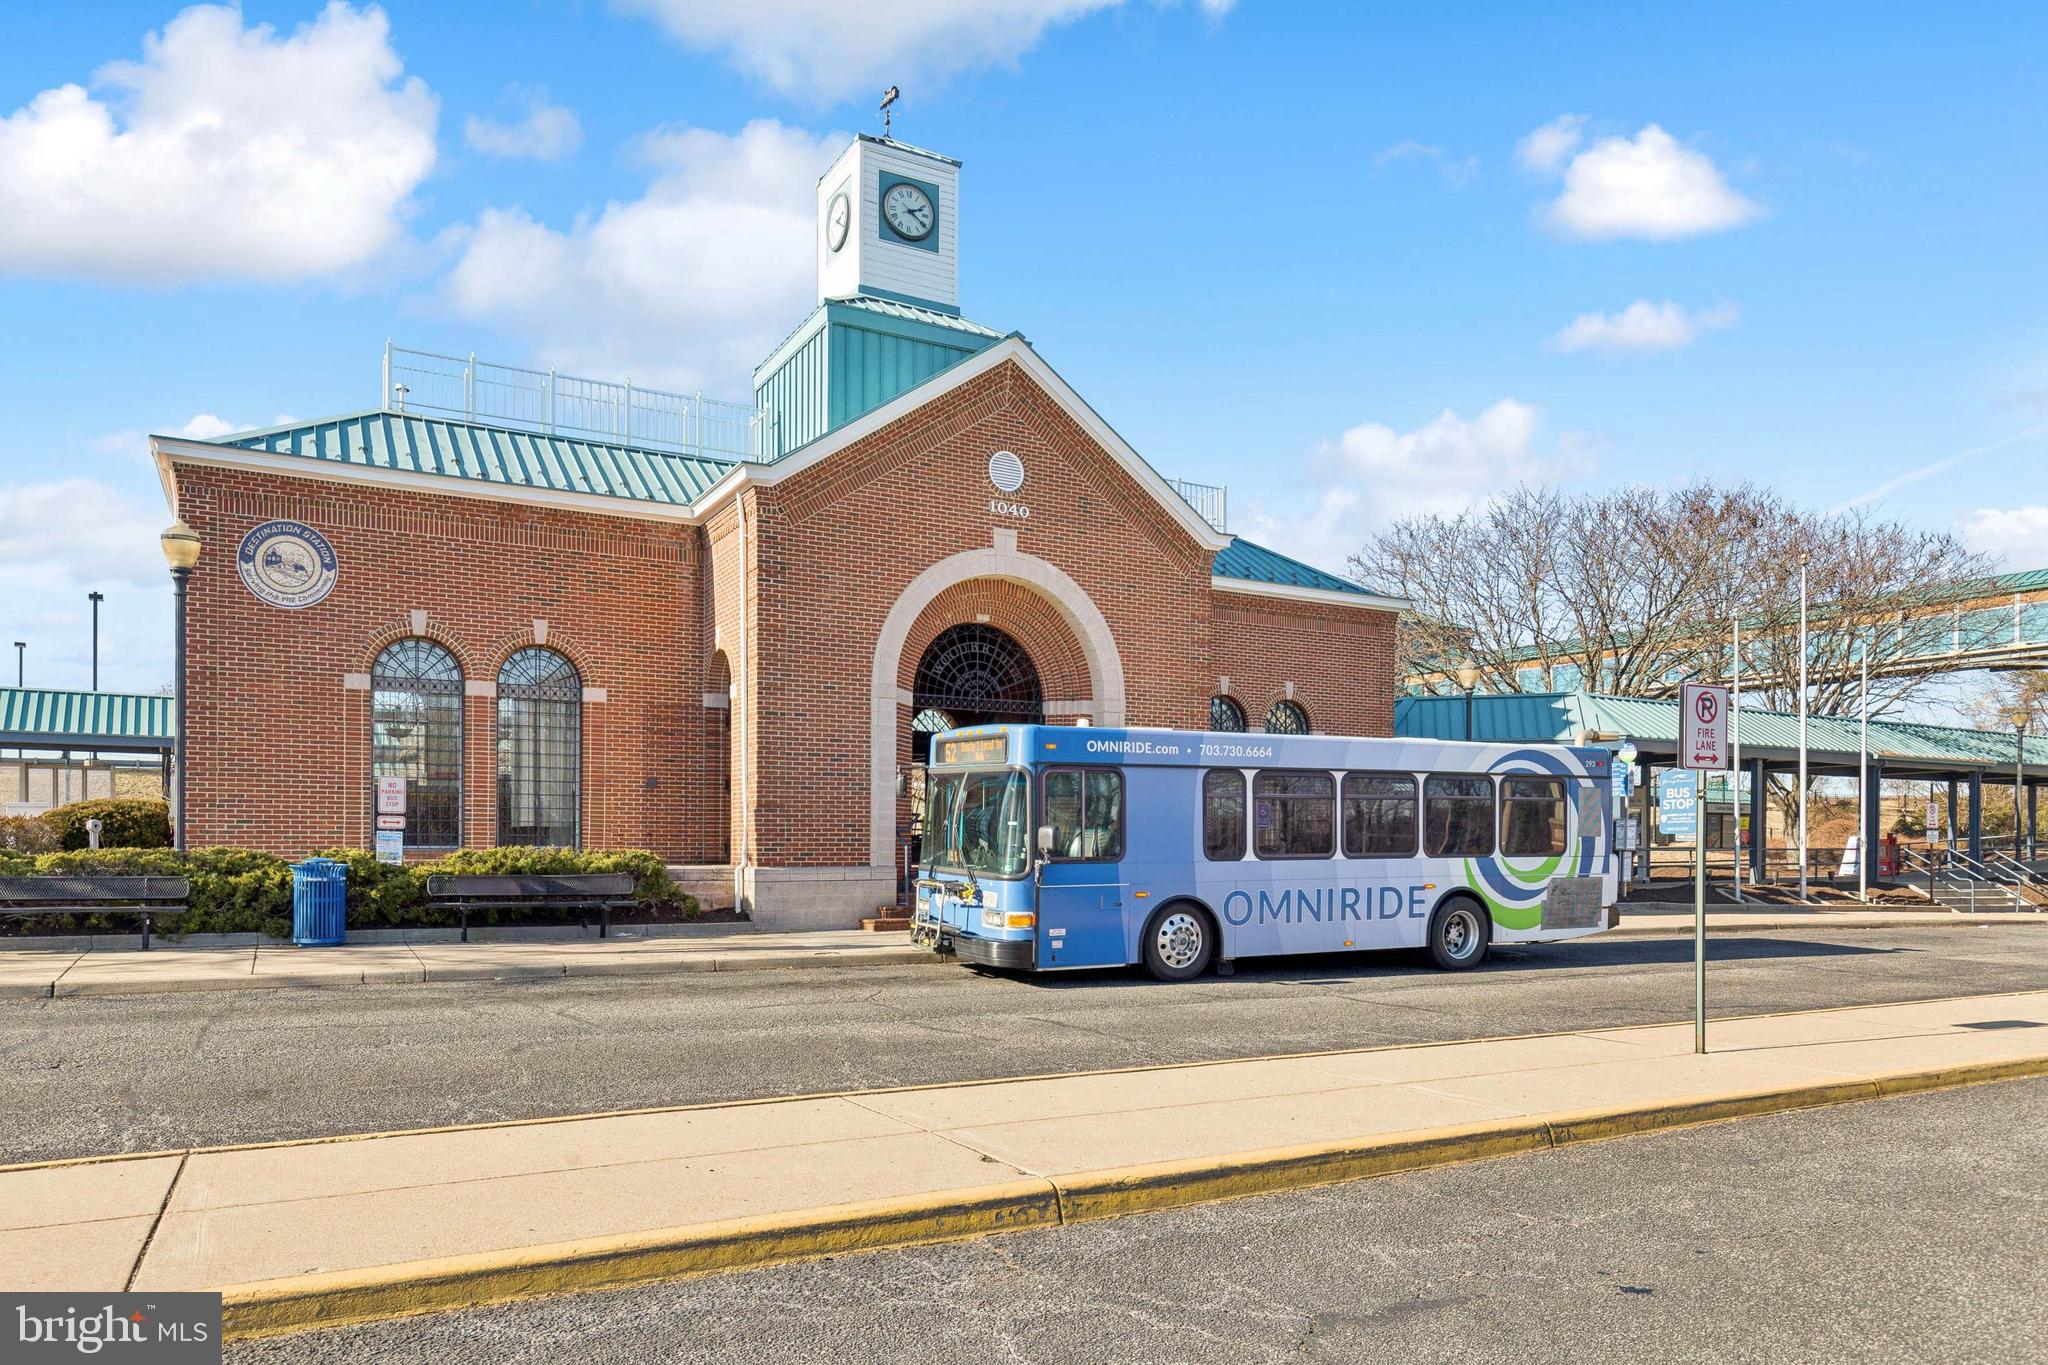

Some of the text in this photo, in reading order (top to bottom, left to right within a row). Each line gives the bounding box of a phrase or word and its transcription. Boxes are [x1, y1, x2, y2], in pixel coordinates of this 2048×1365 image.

[988, 501, 1029, 518] 1040
[244, 524, 332, 564] DESTINATION STATION
[244, 568, 266, 595] Serving
[298, 575, 333, 602] Community
[1697, 728, 1715, 739] FIRE
[1086, 740, 1272, 758] OMNIRIDE.com 703.730.6664
[1695, 741, 1716, 751] LANE
[1666, 787, 1690, 799] BUS
[1663, 798, 1694, 810] STOP
[1222, 885, 1426, 926] OMNIRIDE
